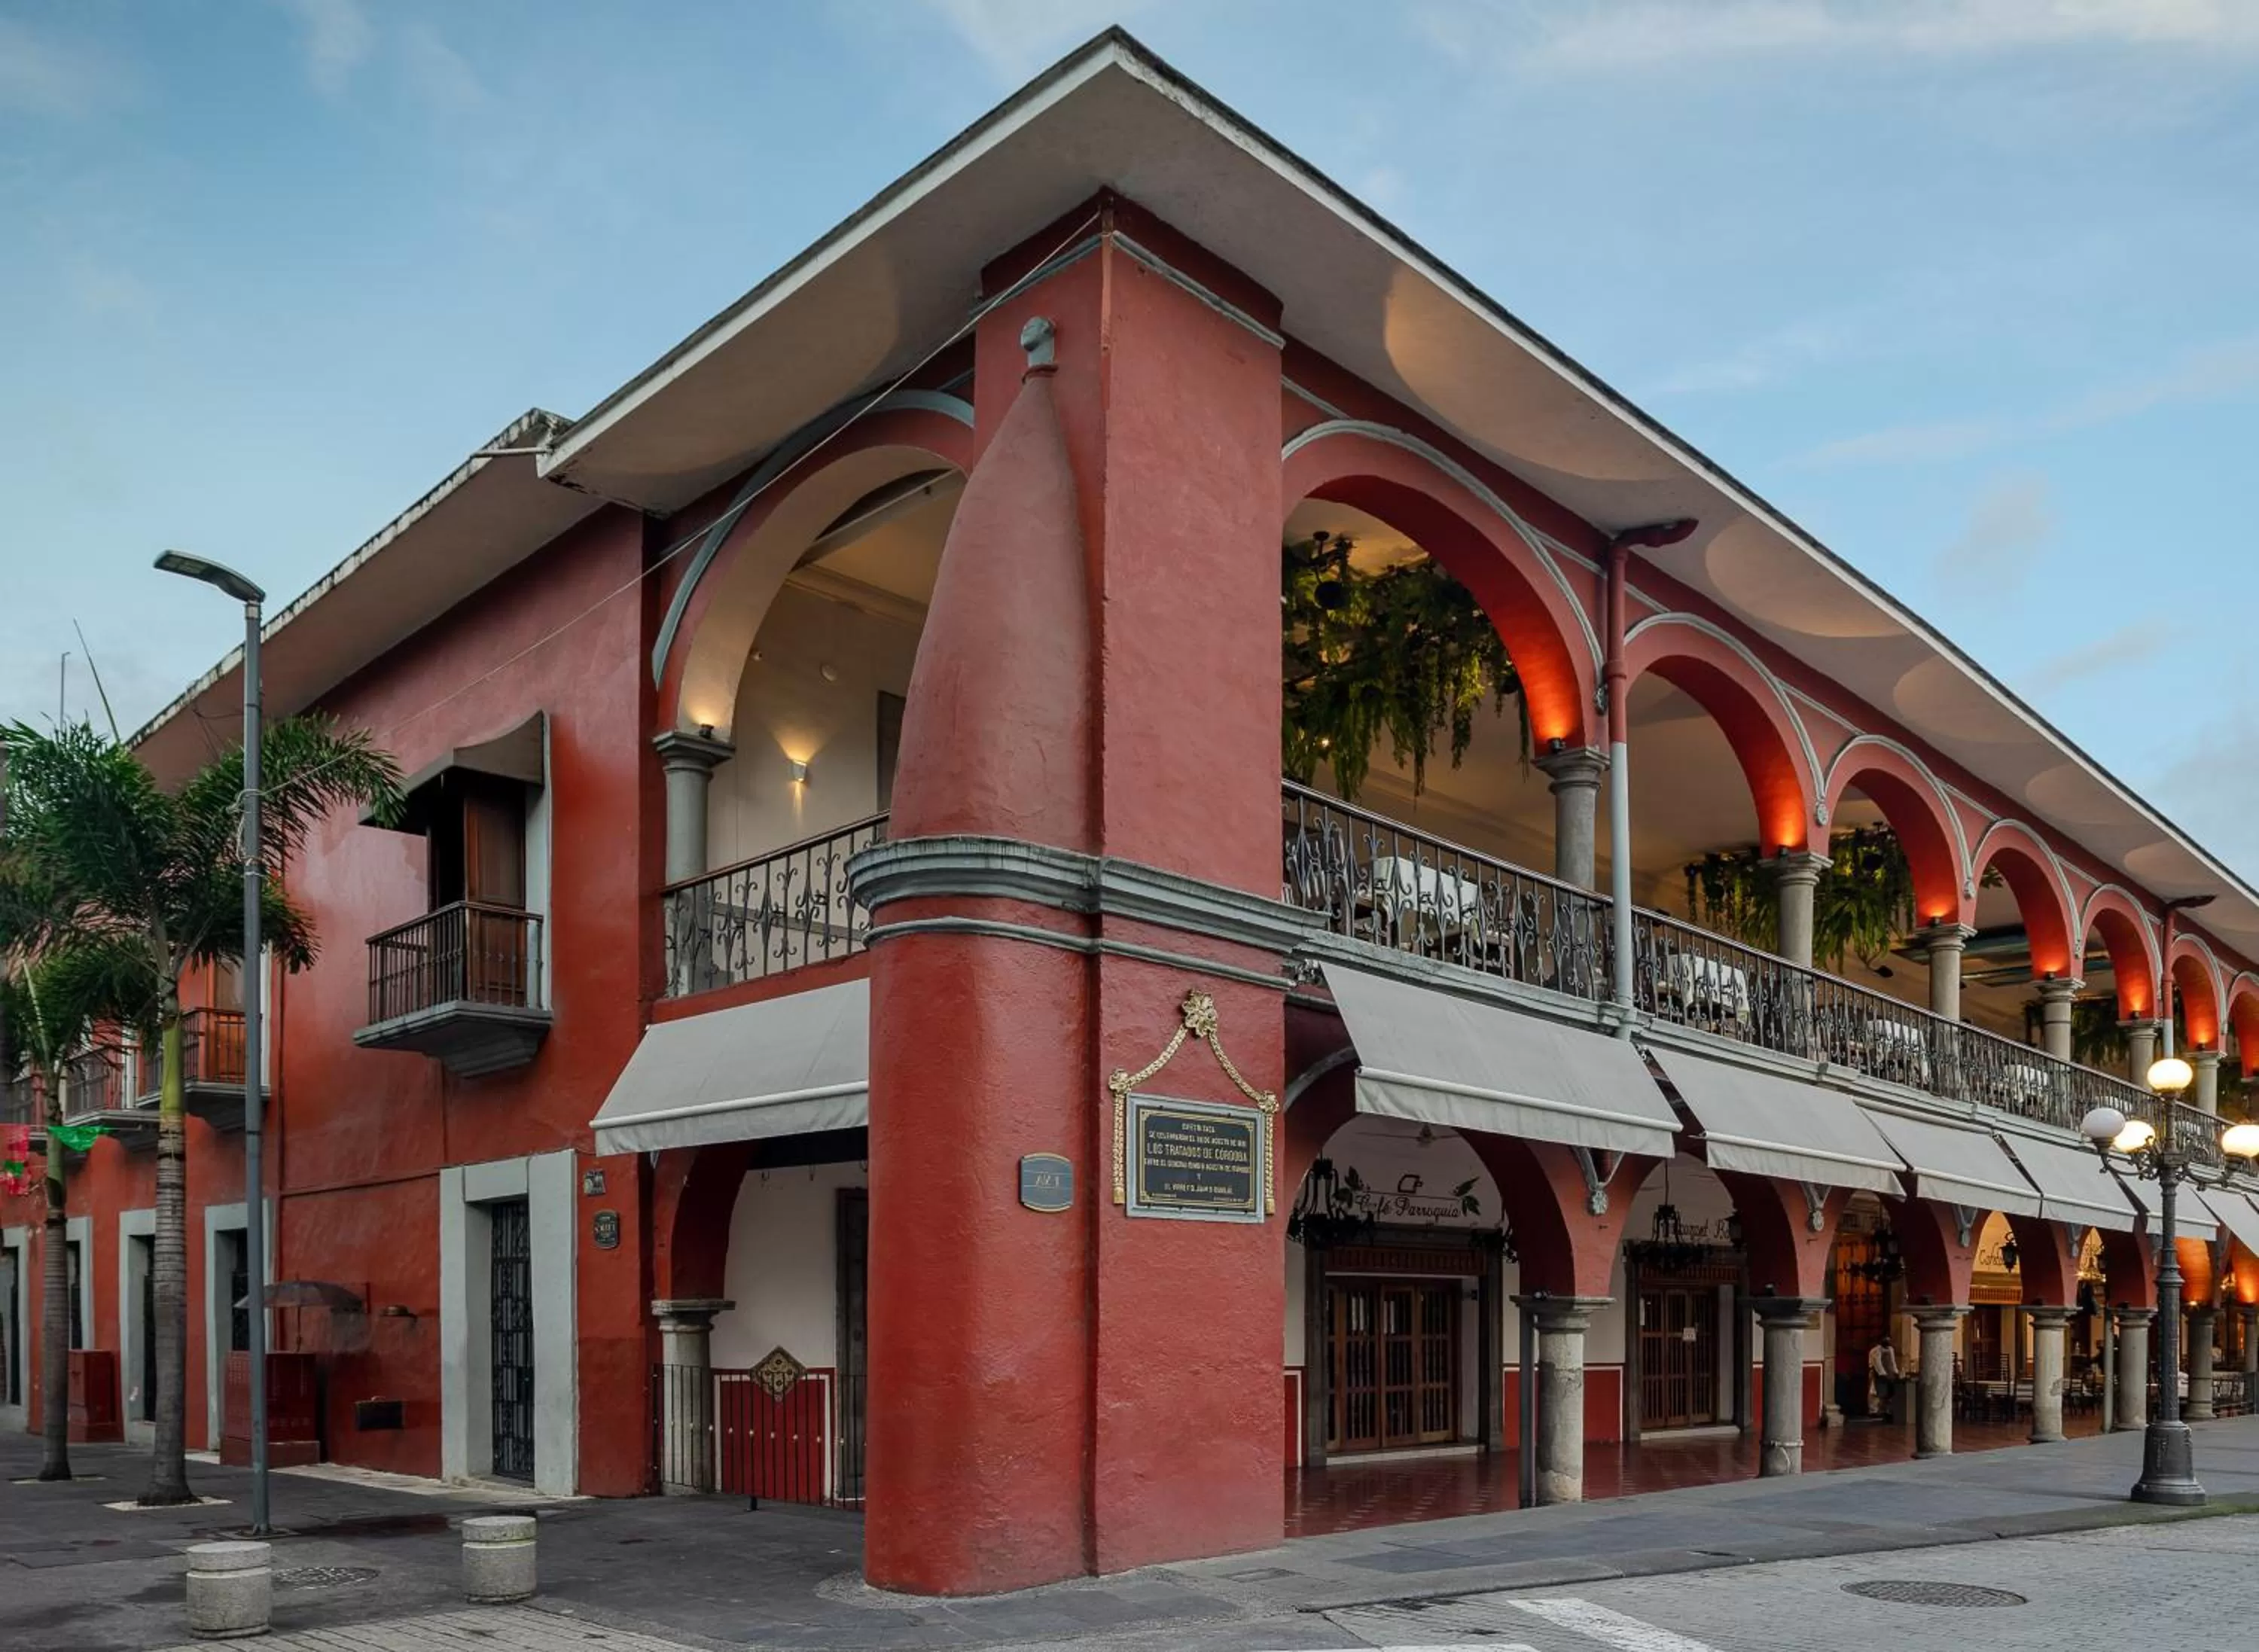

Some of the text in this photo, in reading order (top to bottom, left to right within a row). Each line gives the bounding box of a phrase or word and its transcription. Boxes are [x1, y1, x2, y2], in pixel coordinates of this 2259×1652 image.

[1147, 1142, 1163, 1155] LOS
[1165, 1144, 1203, 1158] TRATADOS
[1203, 1146, 1213, 1160] DE
[1395, 1196, 1459, 1222] Parroquia
